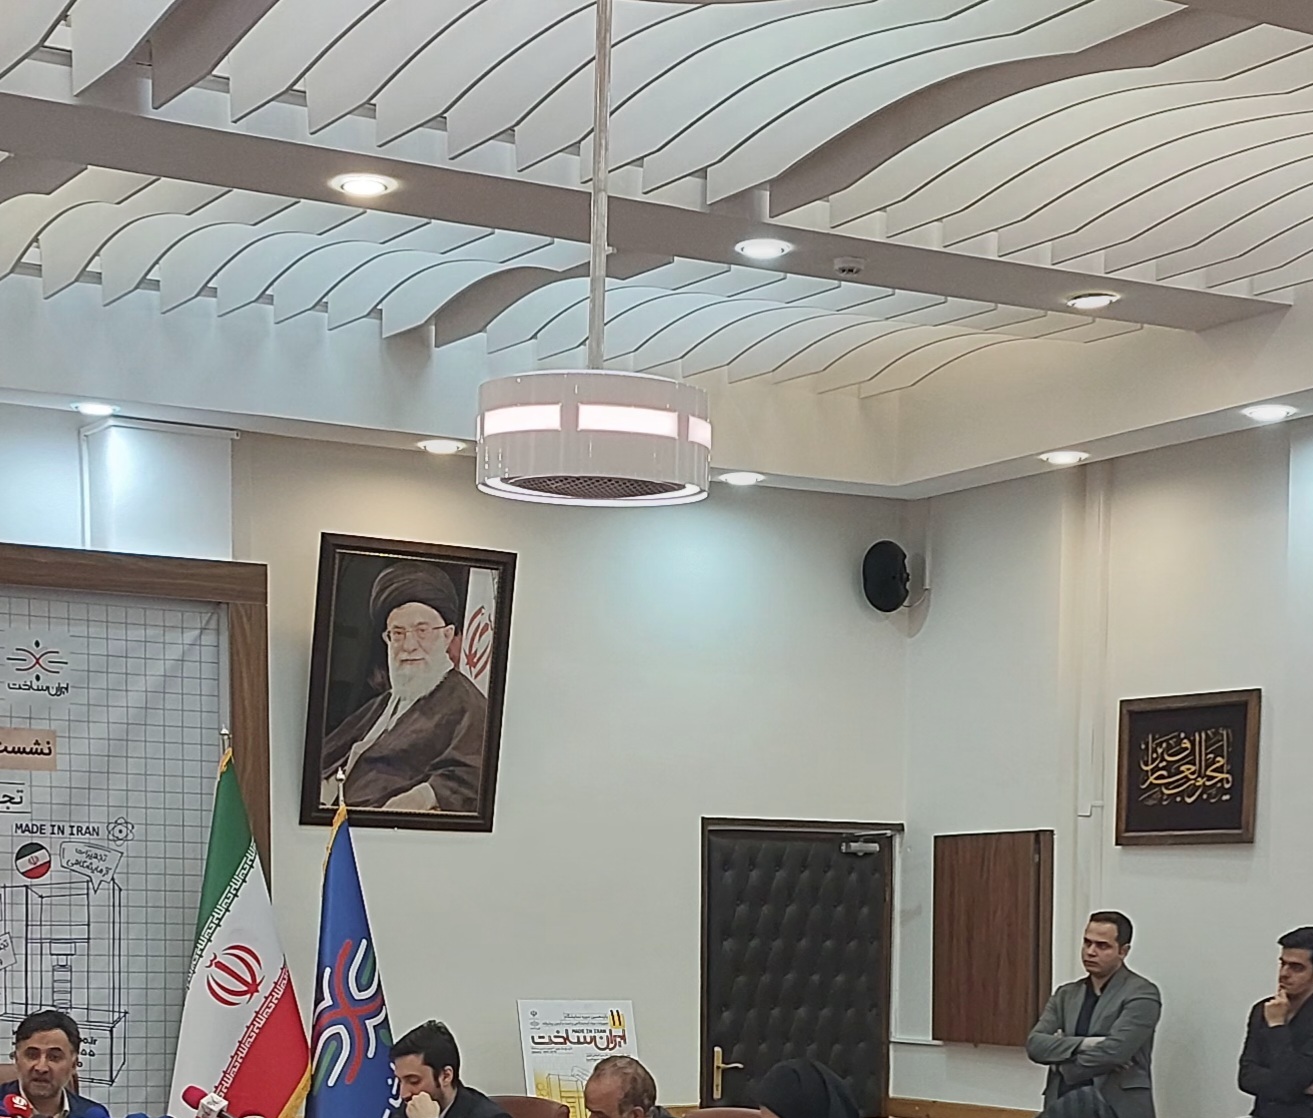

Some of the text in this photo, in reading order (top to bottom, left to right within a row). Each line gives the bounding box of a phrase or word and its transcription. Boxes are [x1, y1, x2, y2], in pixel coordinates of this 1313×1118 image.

[14, 824, 100, 837] MADE IN IRAN
